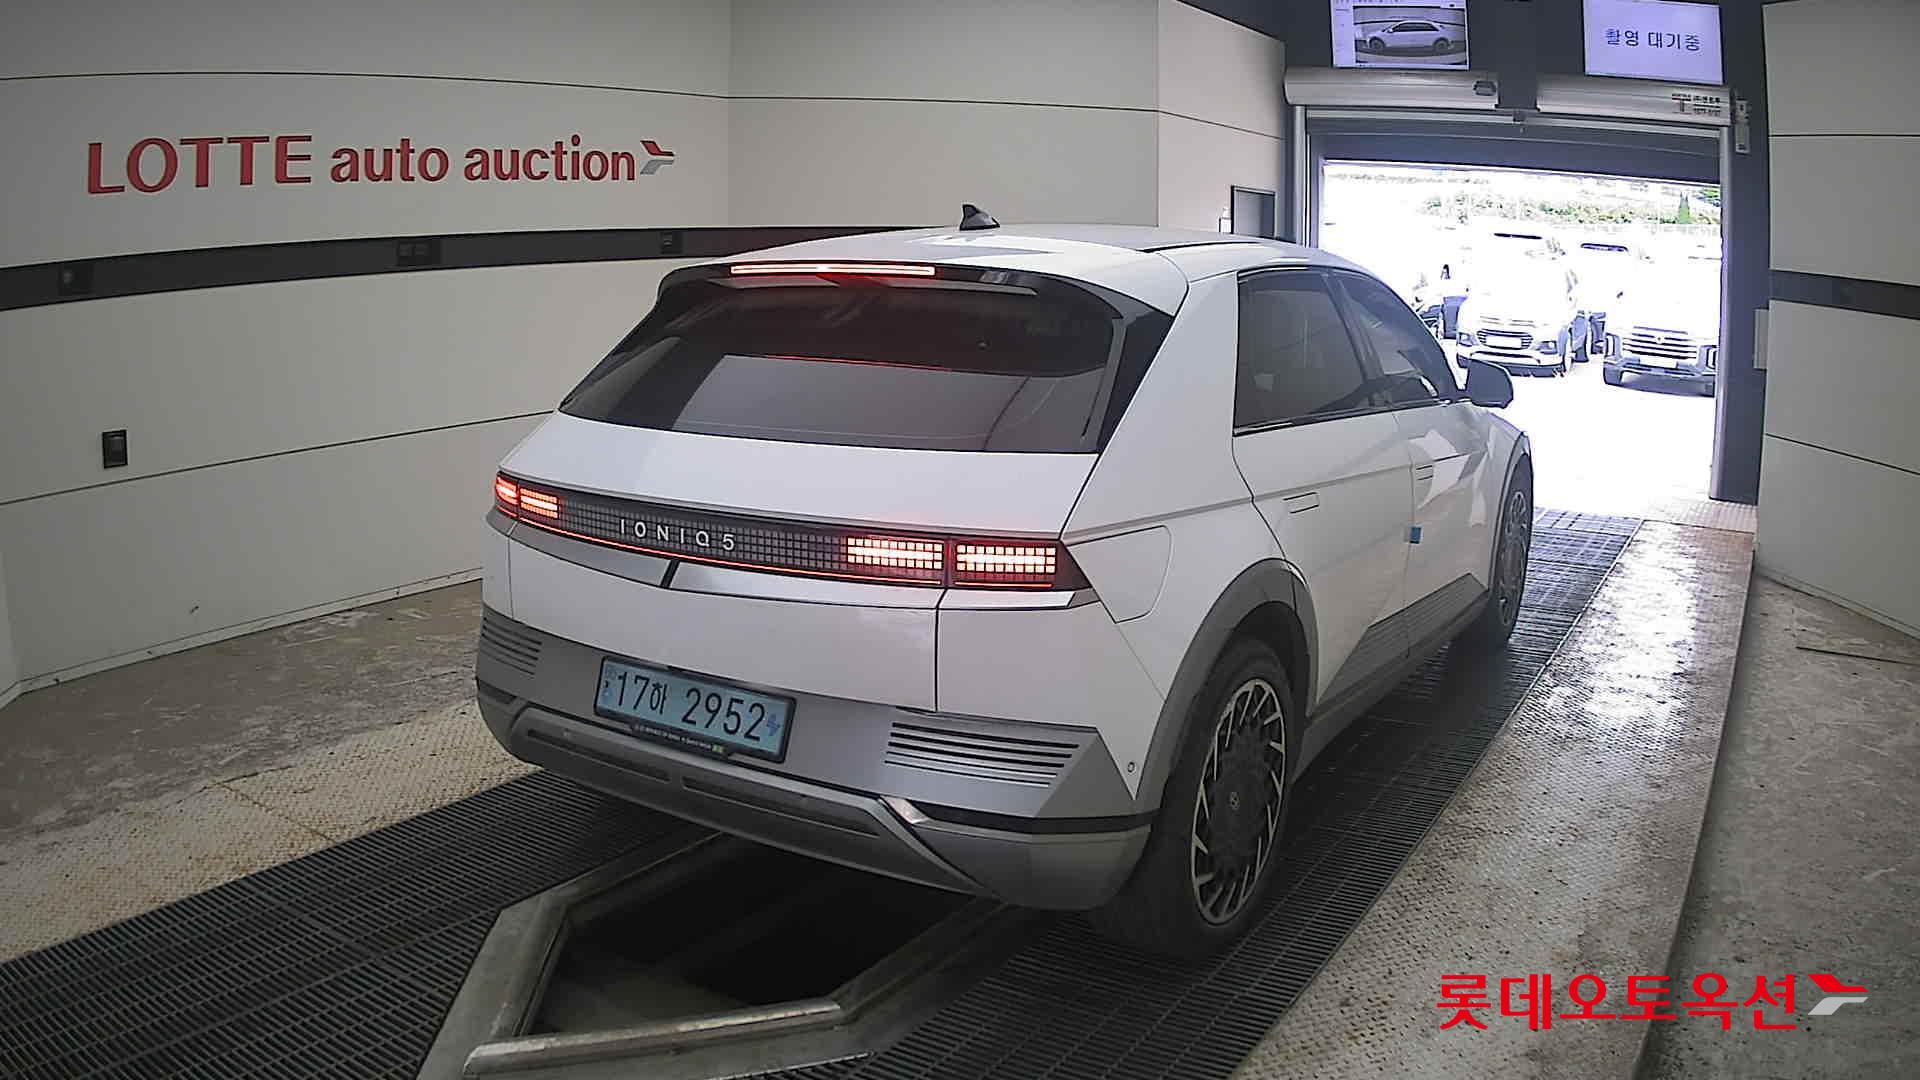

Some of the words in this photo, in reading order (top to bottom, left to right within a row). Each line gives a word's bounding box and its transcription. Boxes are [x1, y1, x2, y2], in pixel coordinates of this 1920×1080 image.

[1648, 31, 1700, 51] 대기중
[88, 135, 312, 194] LOTTE
[330, 138, 449, 182] auto
[463, 134, 636, 181] auction
[617, 671, 668, 715] 17하
[681, 687, 766, 742] 2952
